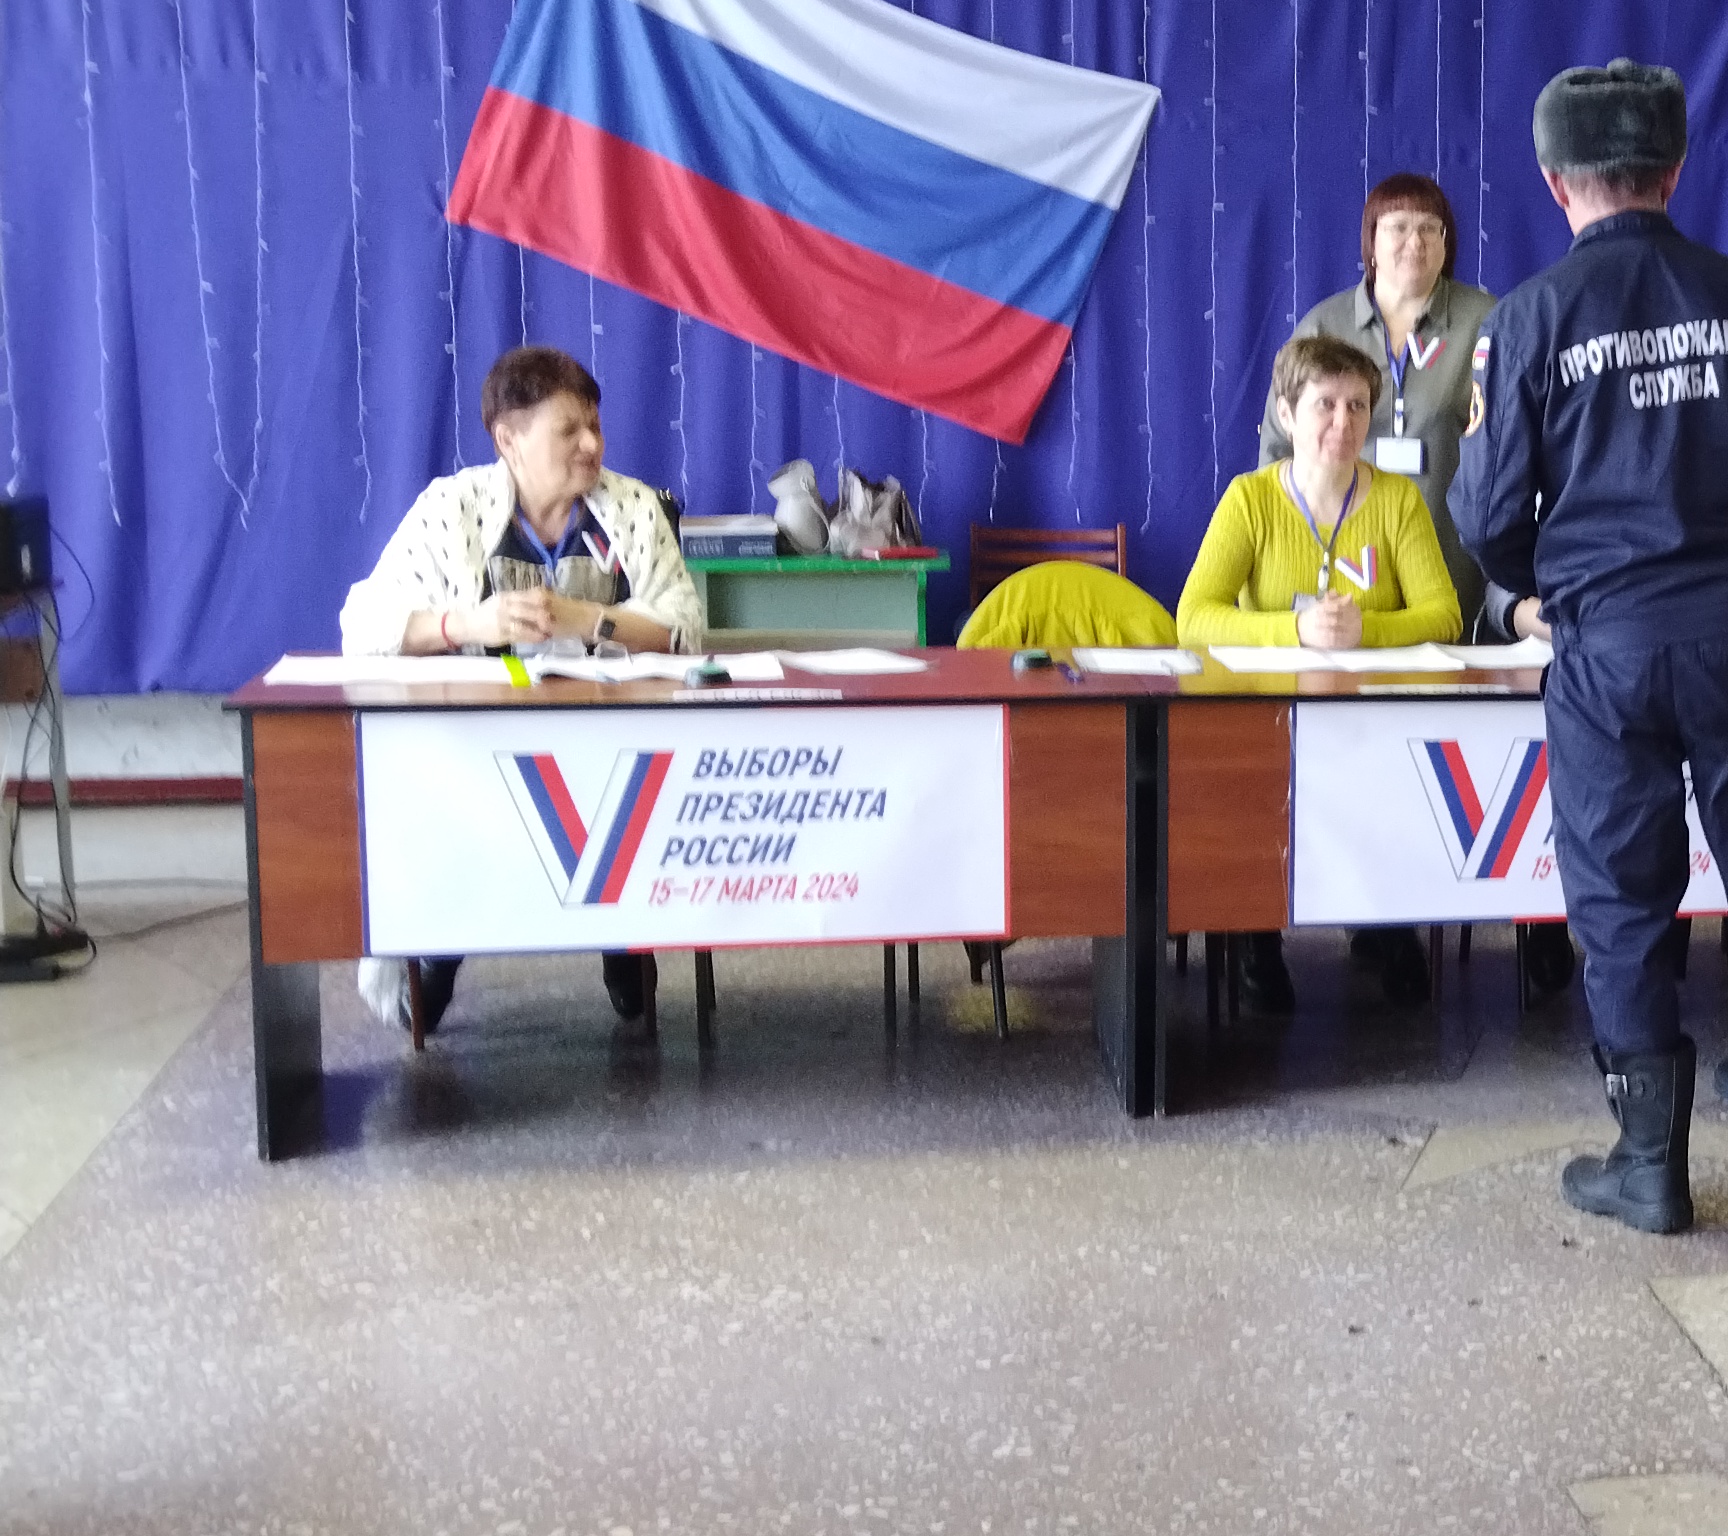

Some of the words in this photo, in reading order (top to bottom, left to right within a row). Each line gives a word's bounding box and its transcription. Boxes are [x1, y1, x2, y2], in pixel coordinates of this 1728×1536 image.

[1629, 362, 1720, 410] СЛУЖБА
[692, 745, 844, 778] ВЫБОРЫ
[676, 786, 887, 825] ПРЕЗИДЕНТА
[659, 832, 798, 868] РОССИИ
[716, 874, 798, 904] МАРТА
[801, 872, 859, 903] 2024
